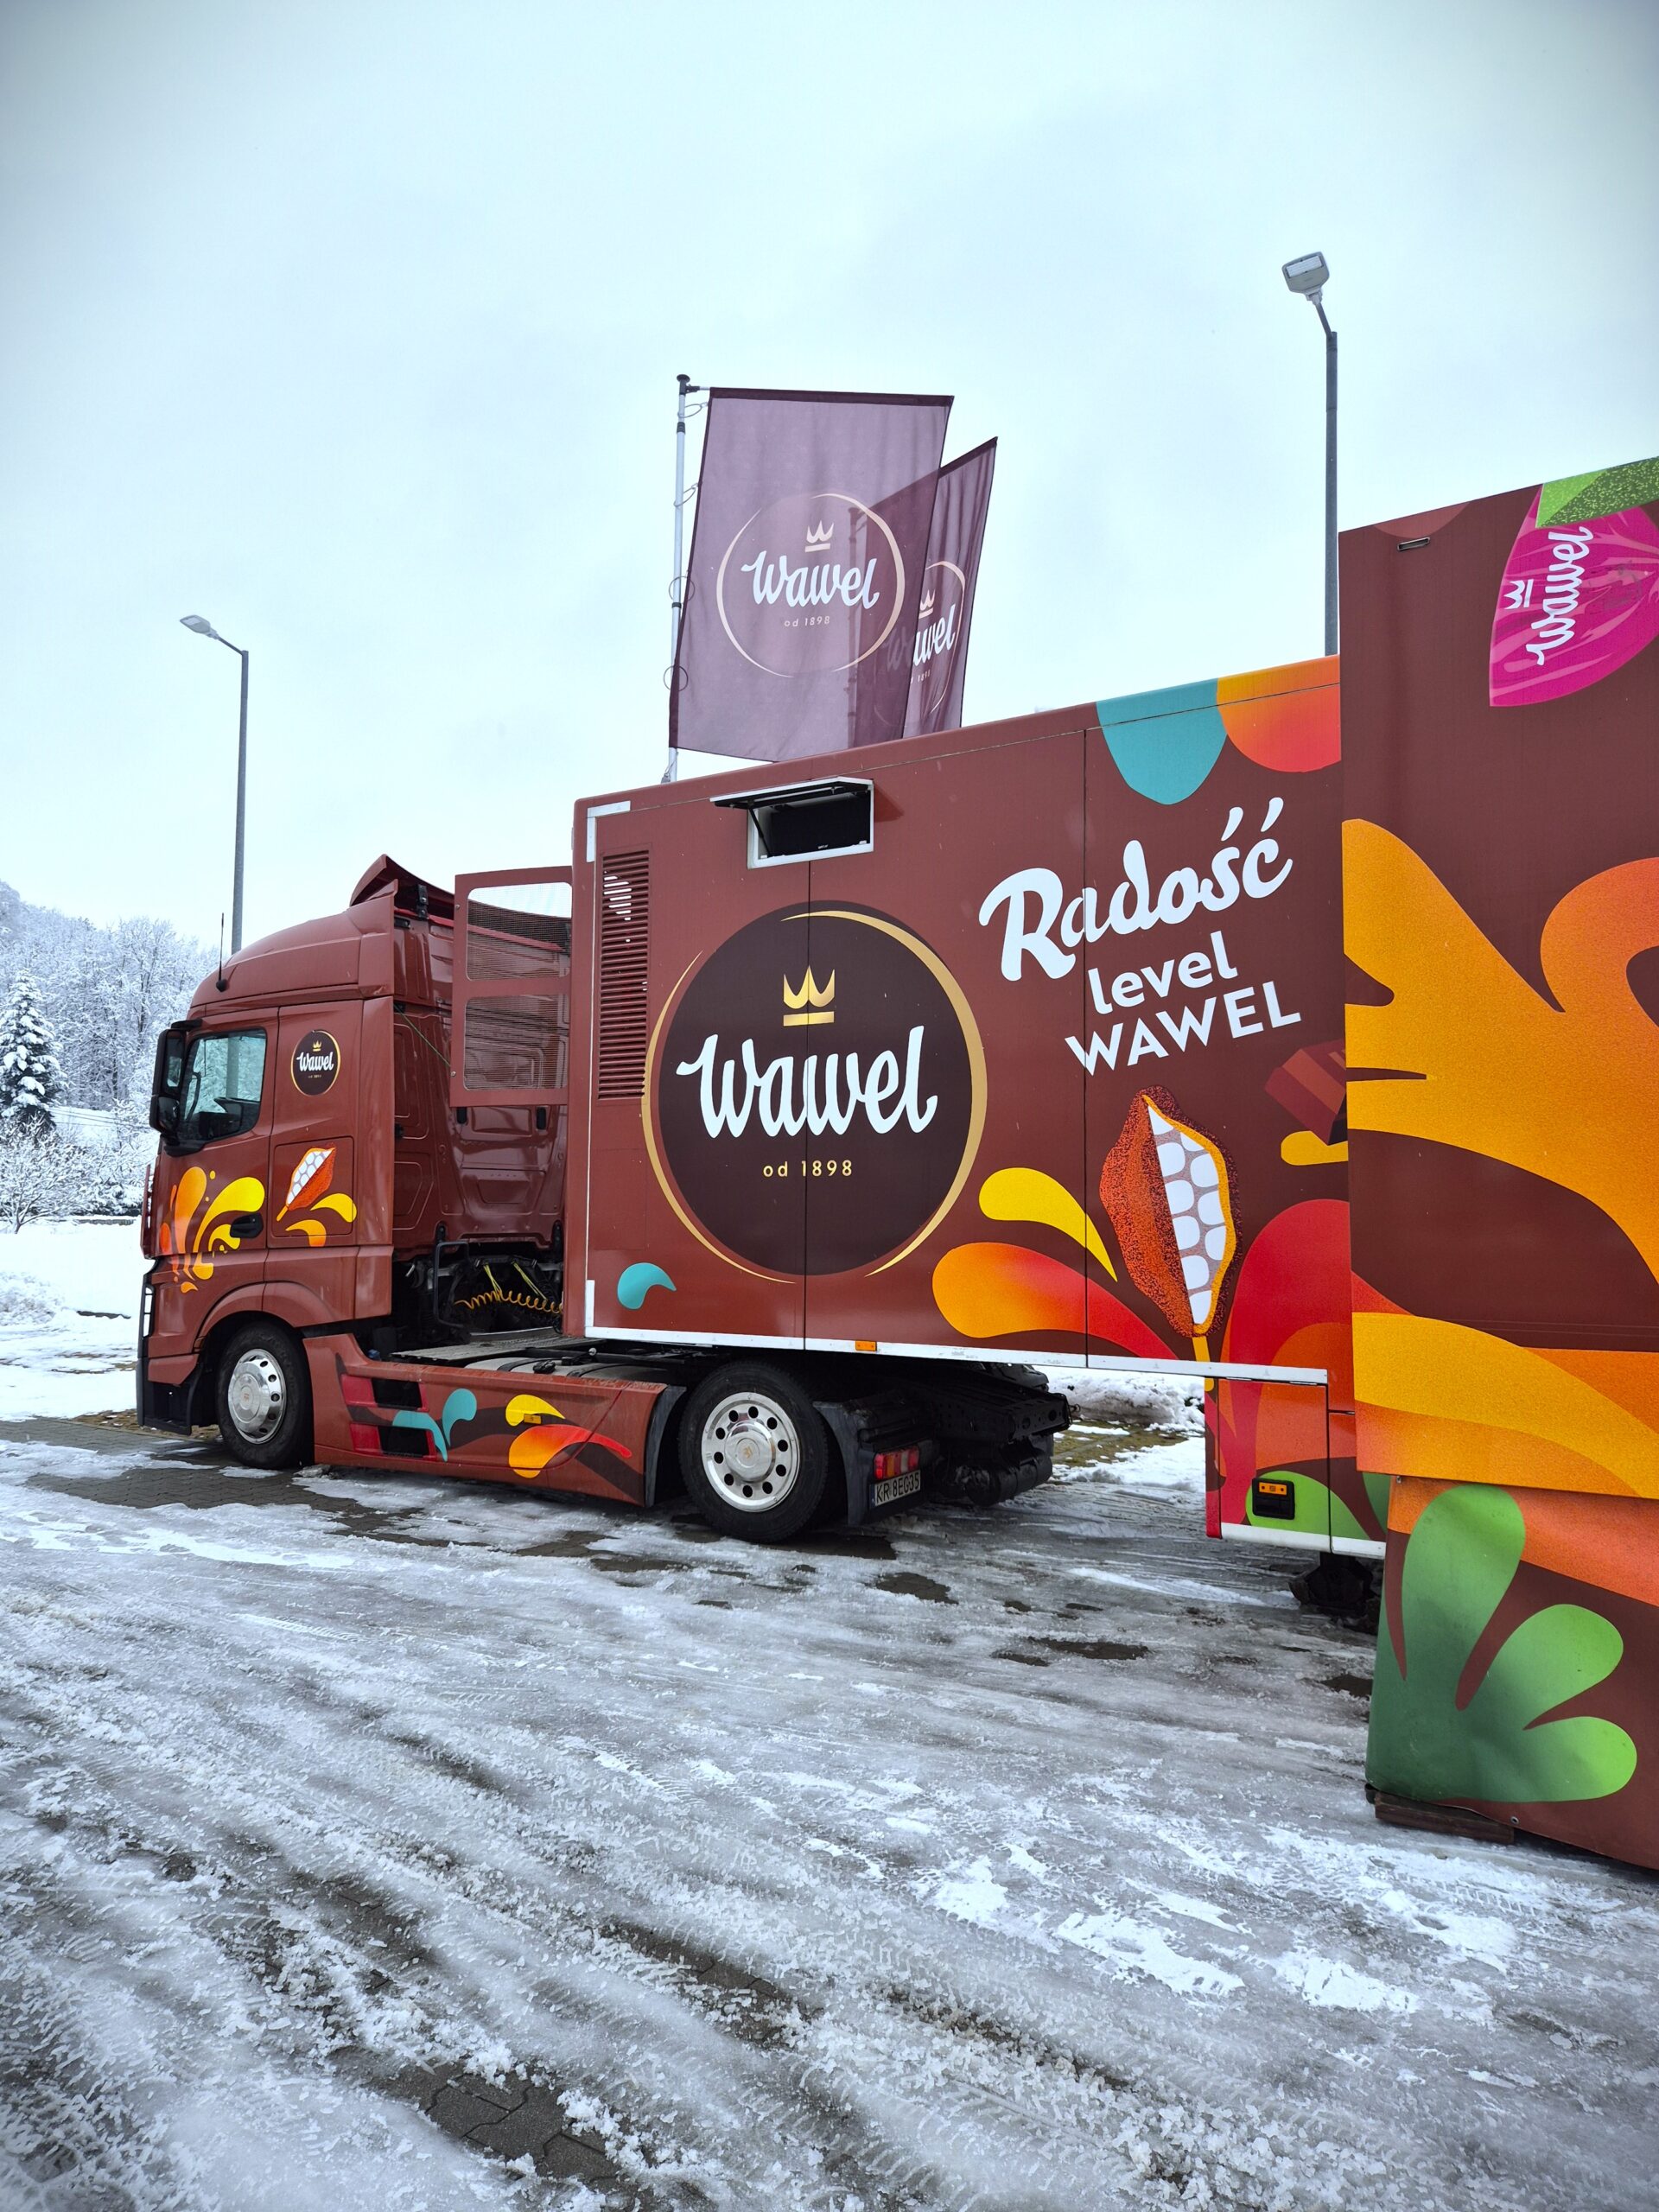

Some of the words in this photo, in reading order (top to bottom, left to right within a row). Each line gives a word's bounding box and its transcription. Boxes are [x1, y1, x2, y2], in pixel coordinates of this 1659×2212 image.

[741, 550, 880, 609] Wawel
[1526, 526, 1593, 665] Wawel
[784, 619, 799, 627] od
[804, 615, 830, 626] 1898
[979, 798, 1293, 982] Radość
[1088, 931, 1238, 1014] level
[296, 1052, 334, 1071] Wawel
[1065, 981, 1301, 1076] WAWEL
[676, 1026, 938, 1138] Wawel
[763, 1161, 788, 1177] od
[802, 1160, 852, 1177] 1898
[876, 1482, 889, 1503] KR
